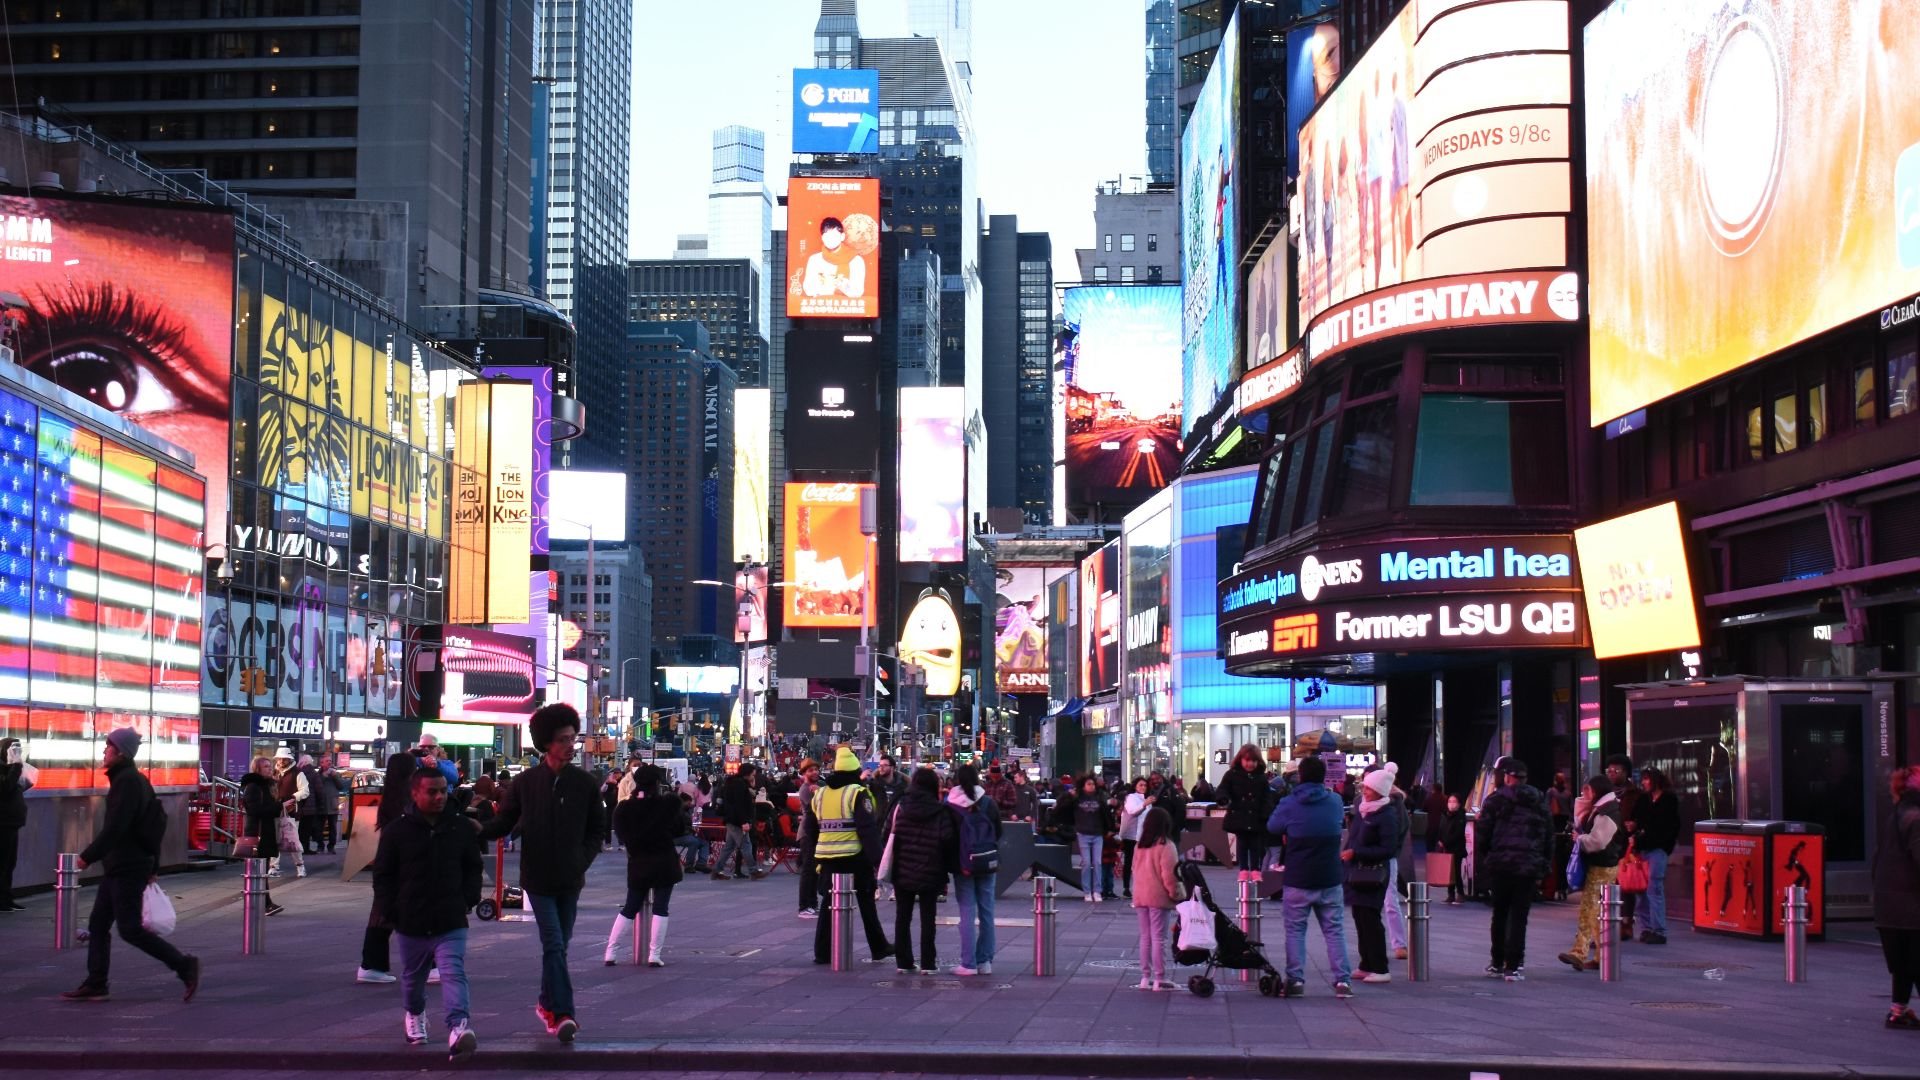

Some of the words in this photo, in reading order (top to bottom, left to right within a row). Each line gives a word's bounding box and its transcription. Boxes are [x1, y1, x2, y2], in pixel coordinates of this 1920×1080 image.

[827, 87, 869, 103] PGIM
[1424, 128, 1503, 168] WEDNESDAYS
[1509, 123, 1551, 146] 9/8c
[6, 246, 52, 262] LENGTH
[1353, 280, 1539, 340] ELEMENTARY
[357, 417, 397, 491] LION
[399, 445, 438, 505] KING
[501, 473, 521, 482] THE
[493, 505, 527, 524] KING
[497, 486, 524, 503] LION
[1244, 574, 1277, 605] following
[1277, 570, 1296, 597] ban
[1319, 559, 1363, 588] NEWS
[1380, 548, 1494, 582] Mental
[1504, 547, 1570, 577] hea
[1127, 614, 1139, 651] OLD
[1139, 606, 1159, 647] NAVY
[1273, 613, 1318, 653] ESPN
[1335, 612, 1432, 642] Former
[1439, 603, 1512, 636] LSU
[1521, 602, 1575, 635] QB
[239, 615, 303, 693] CBS
[258, 715, 324, 735] SKECHERS
[1880, 701, 1889, 757] Newsstand
